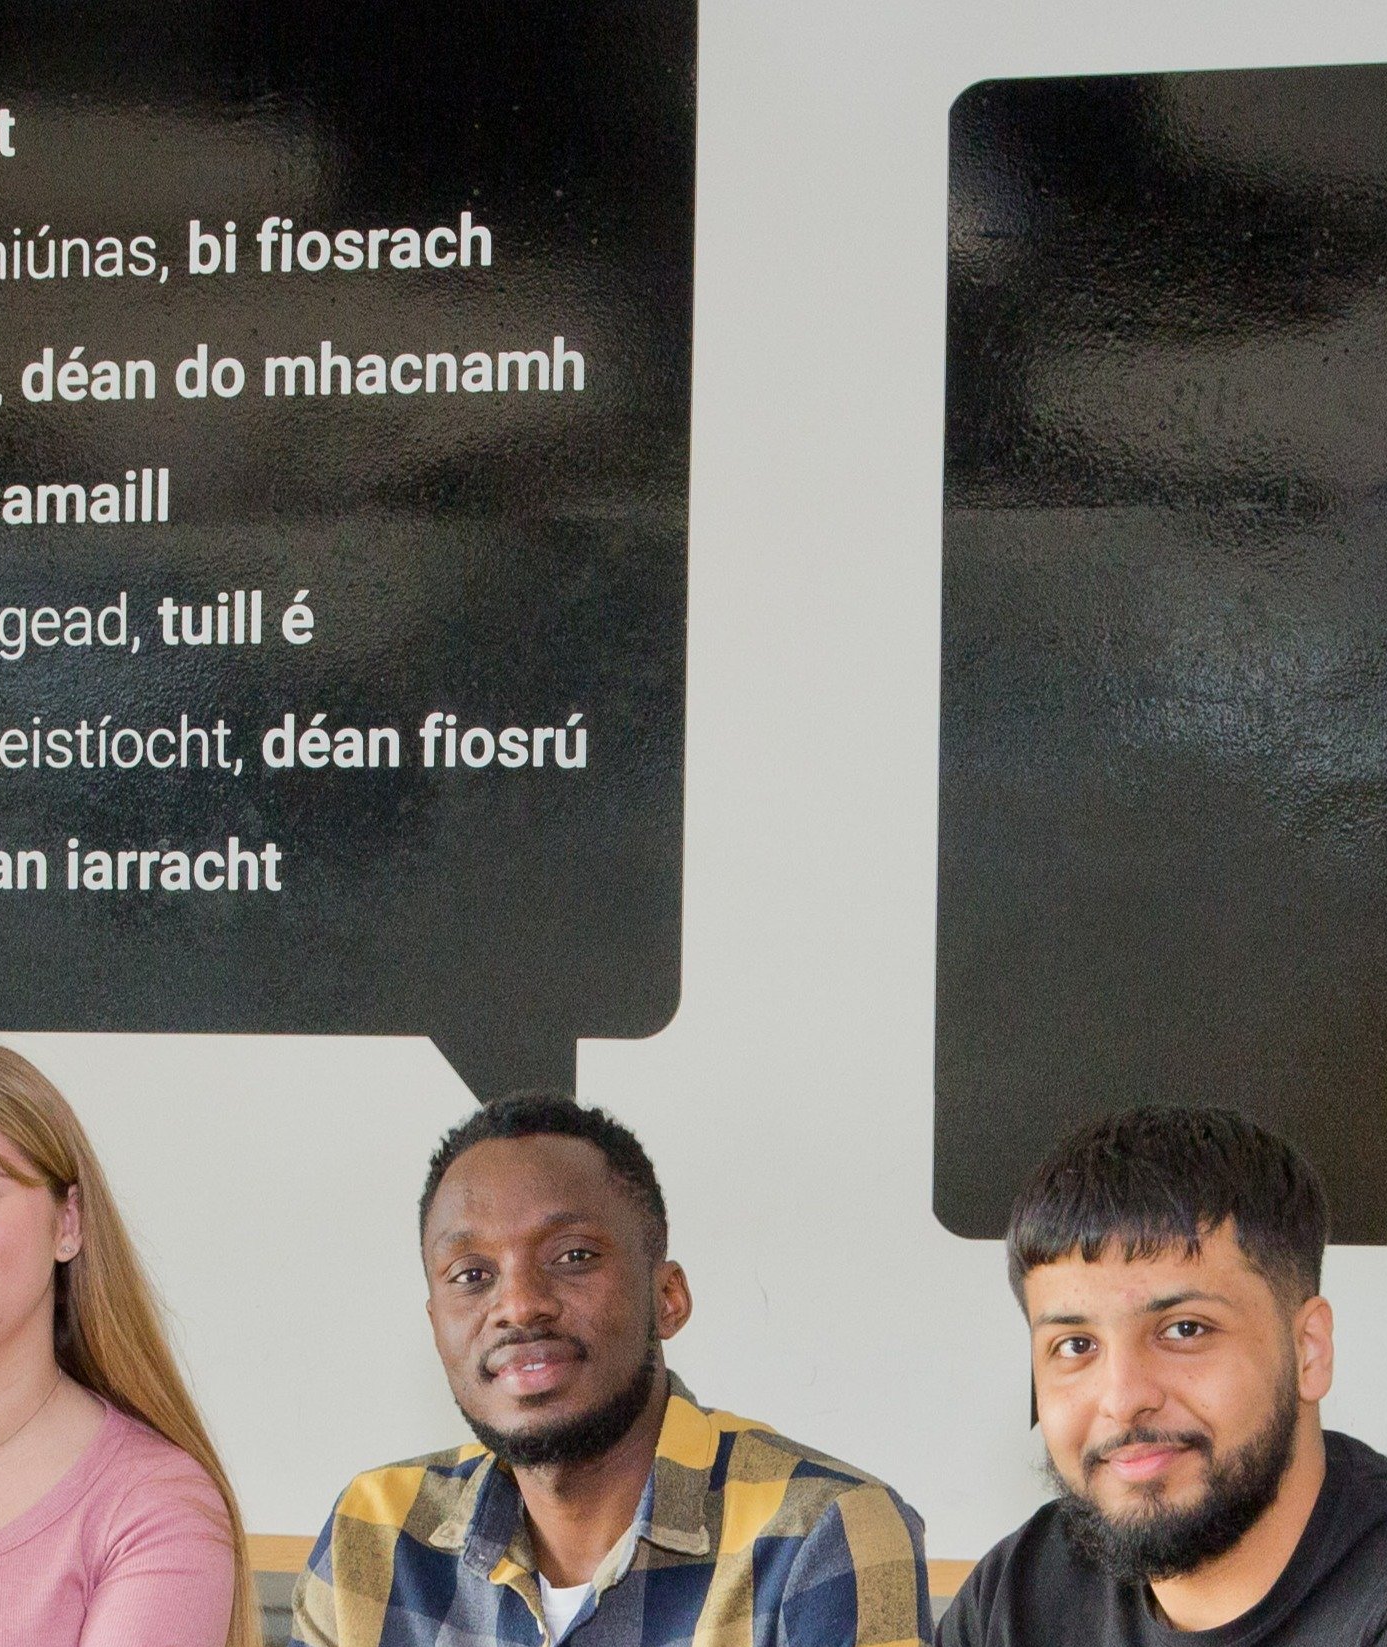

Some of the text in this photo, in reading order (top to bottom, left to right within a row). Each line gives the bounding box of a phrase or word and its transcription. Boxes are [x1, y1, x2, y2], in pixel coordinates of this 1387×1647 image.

[190, 220, 236, 274] bi
[257, 212, 491, 272] fiosrach
[22, 347, 155, 402] déan
[176, 344, 245, 398] do
[265, 336, 584, 396] mhacnamh
[158, 590, 261, 645] tuill
[282, 590, 314, 644] é
[263, 714, 399, 768] déan
[420, 713, 586, 768] fiosrú
[68, 837, 281, 891] iarracht
